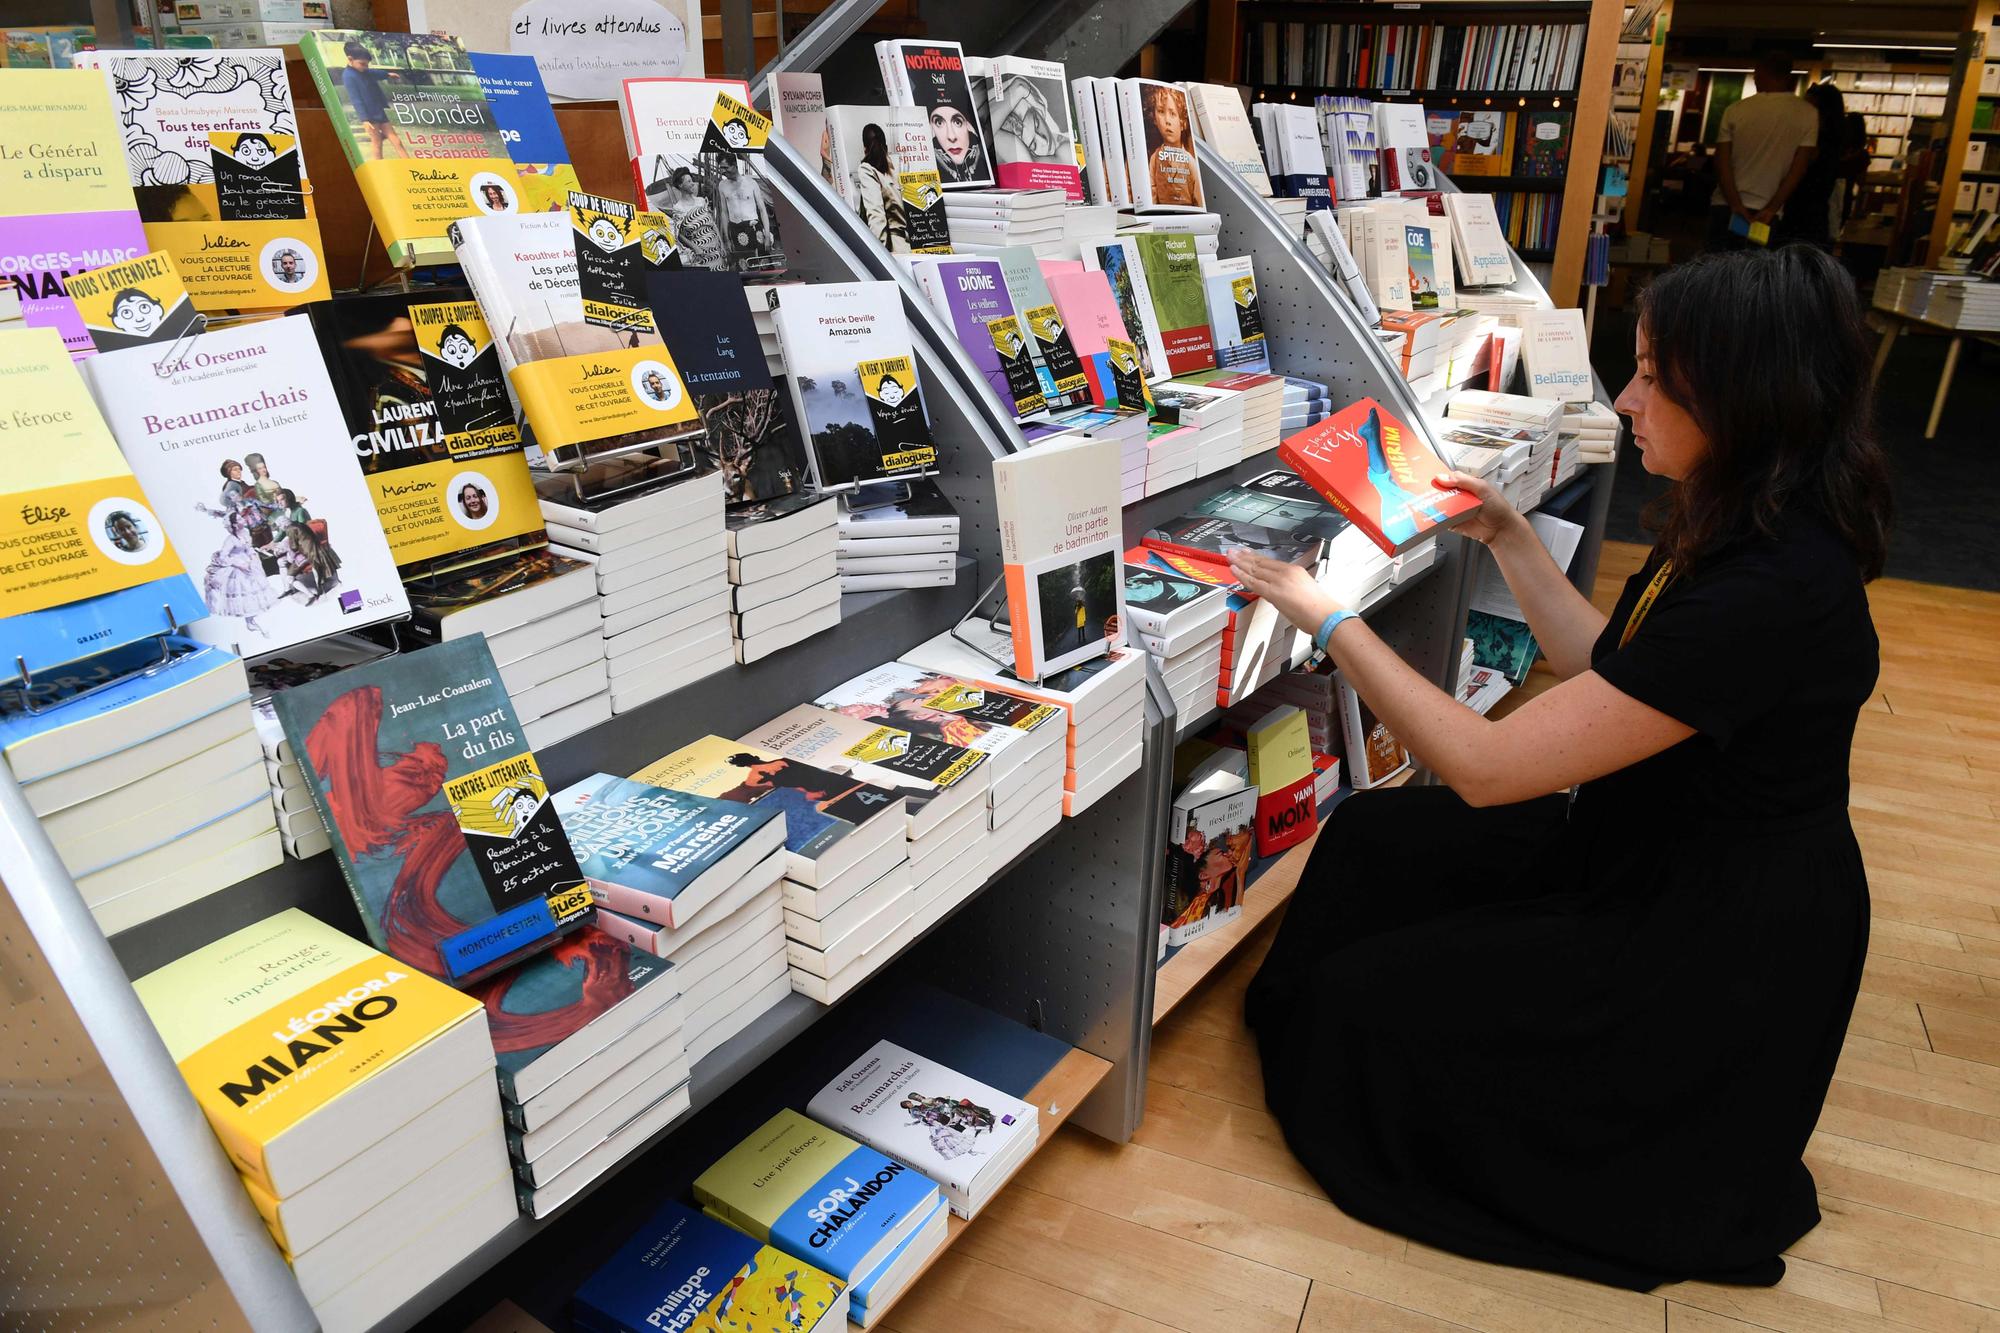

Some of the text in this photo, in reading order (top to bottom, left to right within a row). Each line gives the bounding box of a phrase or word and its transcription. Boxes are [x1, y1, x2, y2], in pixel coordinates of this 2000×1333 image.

[515, 16, 661, 35] et livres attendus
[906, 55, 962, 71] NOTHOMB
[931, 73, 946, 85] Soif
[391, 91, 460, 102] Jean-Philippe
[783, 91, 804, 100] SYLVAIN
[156, 107, 258, 116] Beata Umubyeyi Mairesse
[393, 103, 486, 125] Blondel
[716, 93, 765, 130] VOUS L'ATTENDIEZ
[157, 118, 261, 132] Tous tes enfants
[656, 117, 693, 127] Bernard
[185, 137, 210, 151] disp
[406, 132, 484, 147] La grande
[666, 131, 681, 140] Un
[904, 132, 926, 142] Cora
[0, 142, 98, 159] Le Général
[414, 147, 489, 159] escapade
[896, 142, 928, 153] dans la
[899, 153, 929, 165] spirale
[1158, 151, 1189, 163] SPITZER
[38, 163, 102, 182] disparu
[220, 171, 270, 182] Un roman
[410, 170, 460, 181] Pauline
[1306, 177, 1320, 186] MARIE
[1298, 188, 1330, 198] DARRIEUSSECQ
[570, 192, 628, 218] COUP DE FOUDRE
[201, 234, 251, 251] Julien
[1166, 241, 1186, 249] Richard
[1408, 232, 1424, 247] COE
[514, 250, 560, 262] Kaouther
[1167, 252, 1196, 260] Wagamese
[1473, 256, 1508, 268] Appanah
[215, 264, 251, 272] LECTURE
[532, 265, 552, 275] Les
[966, 267, 981, 275] FATOU
[1169, 264, 1192, 272] Starlight
[67, 258, 162, 299] VOUS L'ATTENDIEZ
[213, 273, 252, 282] OUVRAGE
[529, 279, 542, 290] de
[958, 275, 995, 292] DIOME
[420, 305, 480, 324] COUPER SOUFFLE
[585, 302, 650, 324] dialogues
[818, 314, 876, 324] Patrick Deville
[716, 334, 730, 344] Luc
[828, 326, 872, 337] Amazonia
[716, 347, 734, 358] Lang
[1166, 343, 1210, 356] RICHARD WAGAMESE
[152, 344, 268, 377] Erik Orsenna
[183, 362, 258, 384] l'Académie française
[581, 365, 621, 381] Julien
[686, 368, 741, 383] La tentation
[1534, 373, 1590, 390] Bellanger
[143, 386, 309, 435] Beaumarchais
[372, 400, 439, 424] LAURENT
[12, 408, 73, 431] féroce
[159, 410, 308, 452] Un aventurier de la liberté
[352, 421, 445, 456] CIVILIZA
[450, 429, 516, 451] dialogues
[1303, 423, 1363, 463] Frey
[453, 444, 519, 460] www.librairiedialogues.fr
[884, 451, 933, 468] dialogues
[381, 481, 437, 498] Marion
[21, 504, 71, 526] Élise
[1067, 505, 1108, 522] Olivier Adam
[1066, 516, 1108, 536] Une partie
[1053, 529, 1109, 554] de badminton
[366, 593, 394, 607] Stock
[77, 629, 114, 645] GRASSET
[390, 675, 493, 718] Jean-Luc Coatalem
[442, 705, 508, 740] La part
[760, 722, 801, 747] Jeanne
[769, 718, 827, 750] Benameur
[462, 728, 516, 760] du fils
[938, 750, 980, 784] dialogues
[449, 759, 532, 802] RENTRÉE LITTÉRAIRE
[660, 768, 697, 789] Goby
[649, 794, 678, 808] ET
[854, 790, 891, 807] 4
[1294, 784, 1313, 802] YANN
[1227, 809, 1244, 818] noir
[1228, 801, 1244, 812] Rien
[569, 795, 651, 845] MILLIONS
[1269, 801, 1311, 836] MOIX
[600, 807, 688, 859] UN JOUR
[652, 813, 738, 871] Mareine
[503, 859, 563, 893] 25 octobre
[258, 943, 320, 973] Rouge
[224, 949, 332, 1005] impératrice
[272, 970, 409, 1044] LÉONORA
[218, 995, 398, 1108] MIANO
[350, 1049, 385, 1073] GRASSET
[836, 1057, 880, 1093] Erik Orsenna
[851, 1061, 914, 1114] Beaumarchais
[753, 1135, 818, 1188] Une joie féroce
[808, 1176, 860, 1222] SORJ
[808, 1161, 906, 1248] CHALANDON
[646, 1266, 711, 1328] Philippe
[662, 1289, 712, 1333] Hayat
